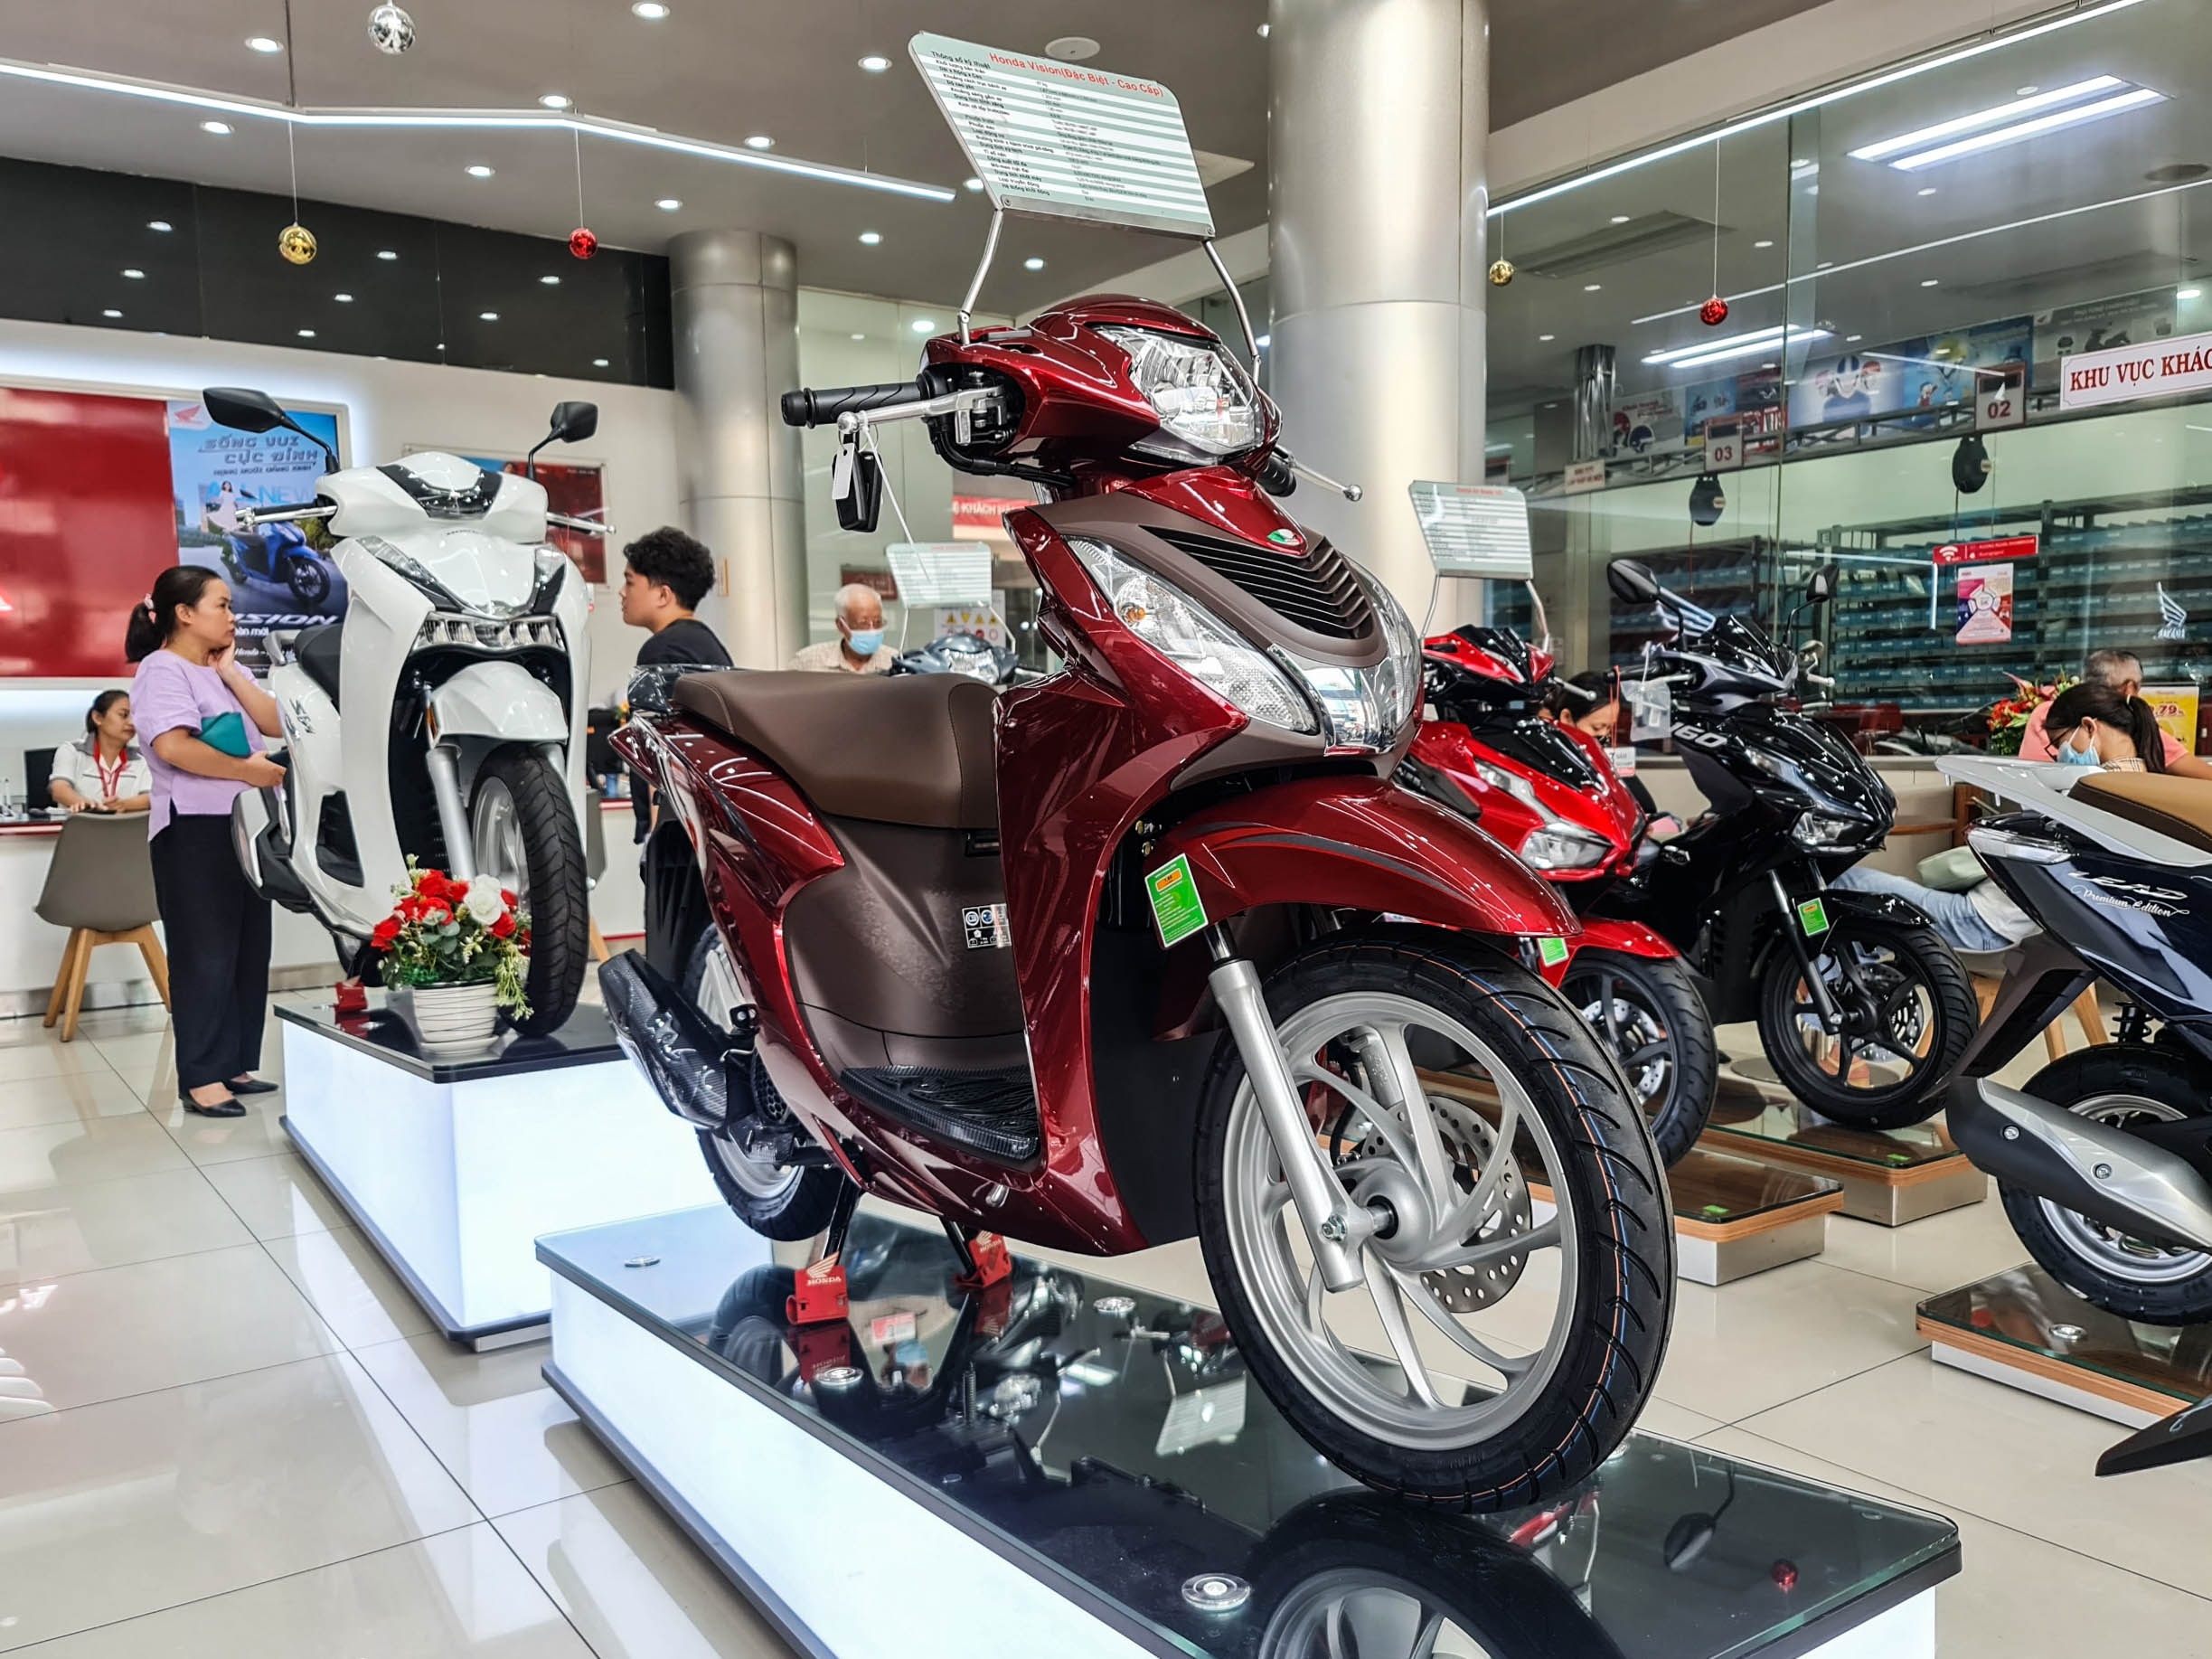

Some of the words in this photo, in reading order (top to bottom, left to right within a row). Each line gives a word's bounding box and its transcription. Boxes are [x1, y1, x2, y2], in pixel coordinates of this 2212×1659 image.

[989, 52, 1026, 70] Honda
[1116, 78, 1138, 91] Cao
[2069, 366, 2111, 391] KHU
[2115, 358, 2155, 387] VỰC
[2160, 345, 2212, 376] KHÁC
[1987, 400, 2011, 419] 02
[1713, 446, 1733, 463] 03
[235, 613, 338, 625] ISION
[2081, 887, 2129, 909] Premium
[2132, 895, 2175, 918] Edition
[806, 1276, 842, 1287] HONDA
